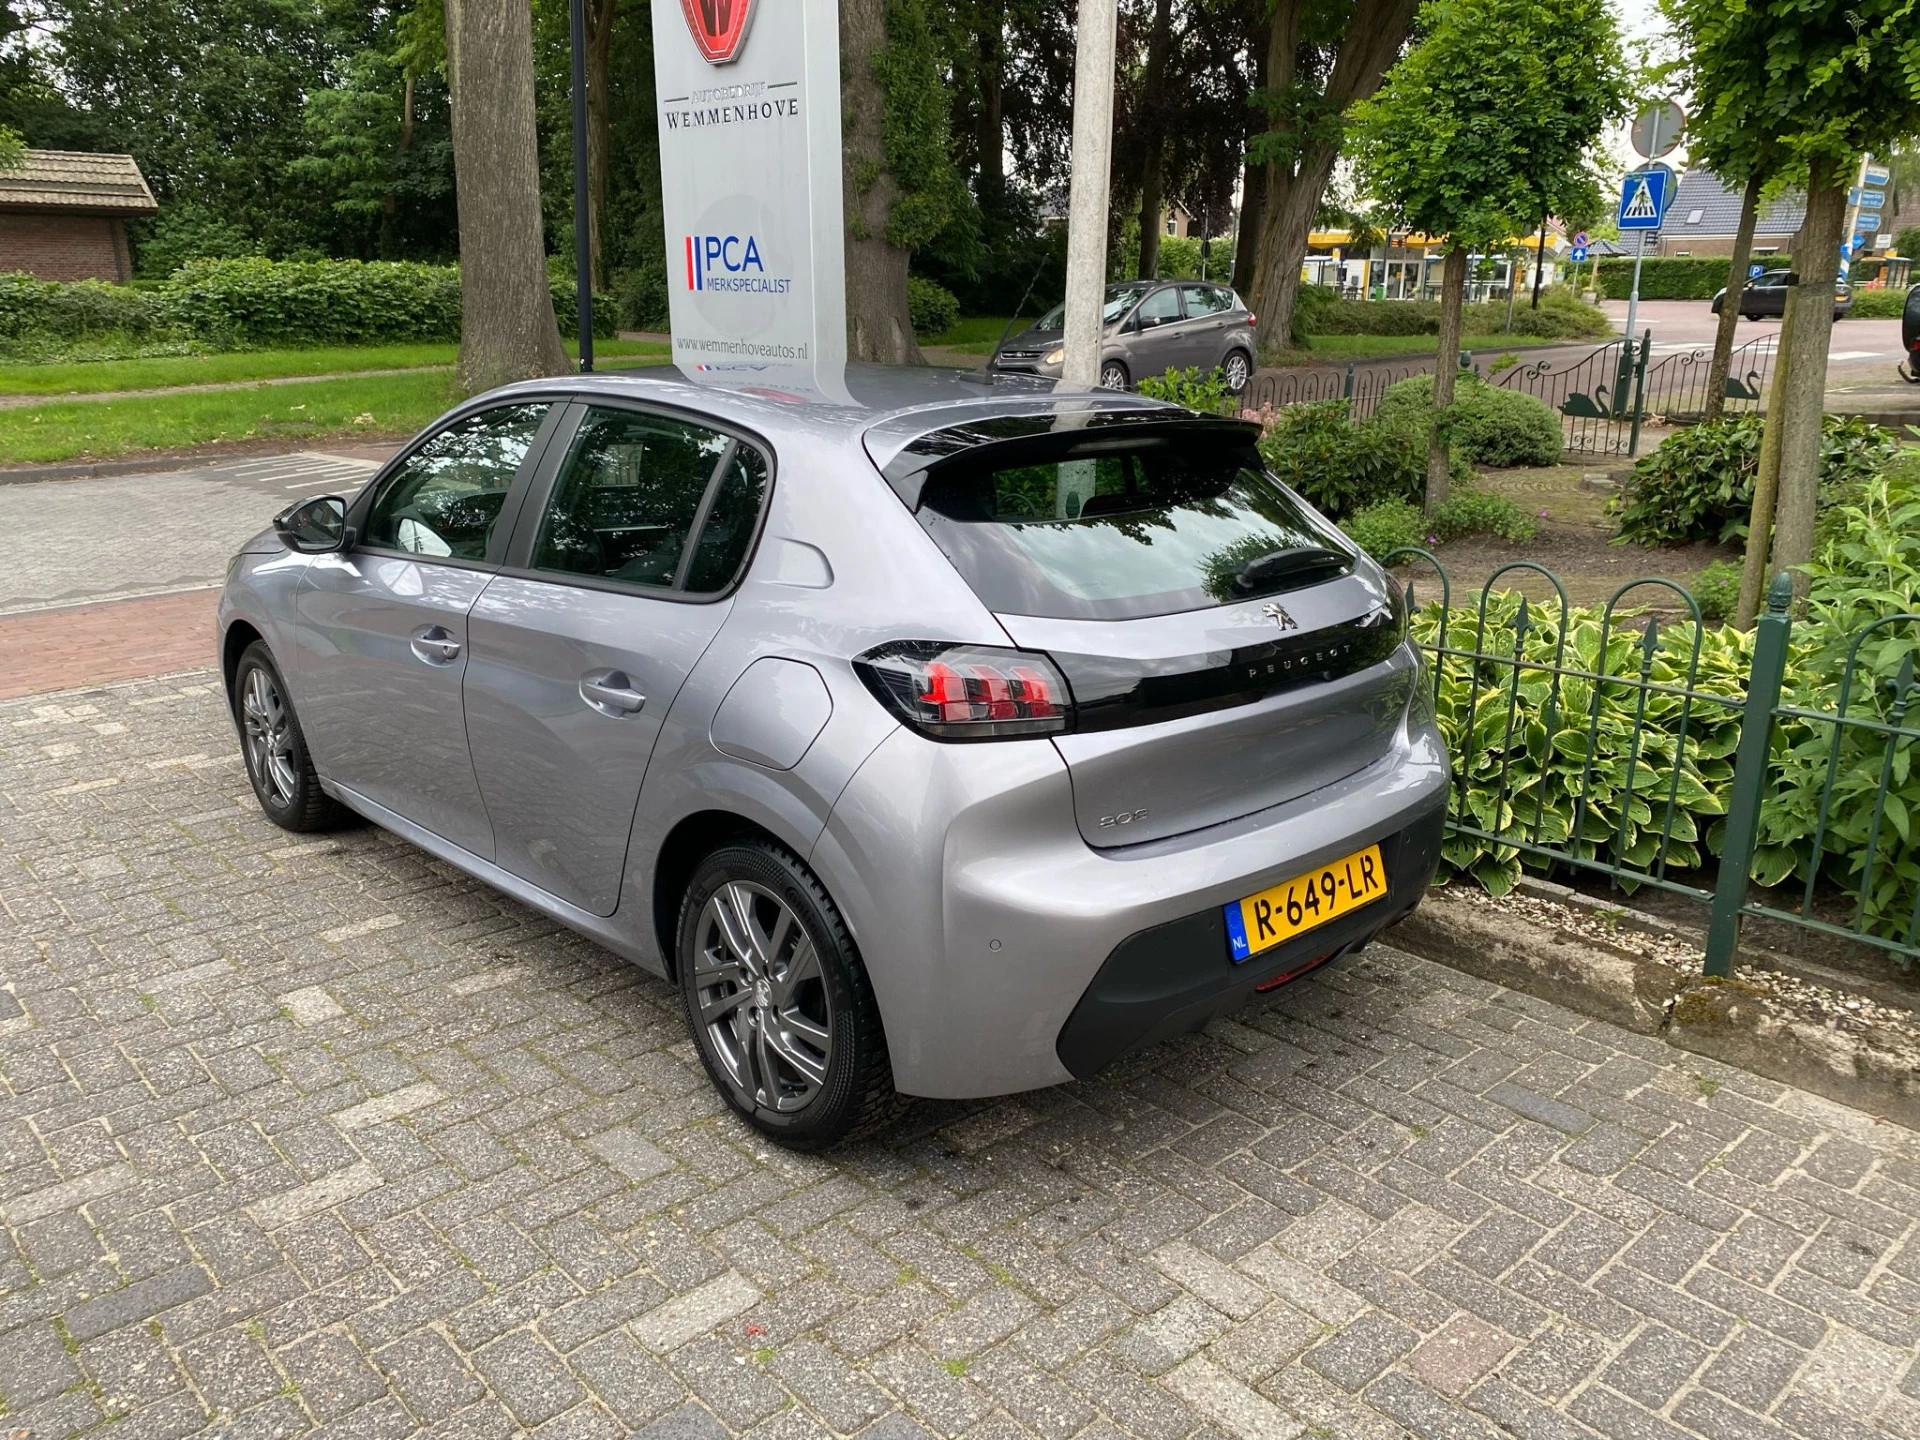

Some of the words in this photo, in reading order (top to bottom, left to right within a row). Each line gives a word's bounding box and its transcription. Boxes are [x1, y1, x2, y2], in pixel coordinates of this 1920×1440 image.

[665, 98, 799, 130] WEMMENHOVE
[705, 235, 764, 272] PCA
[706, 277, 792, 294] MERKSPECIALIST
[677, 337, 809, 360] www.wemmenhoveautos.nl
[1249, 645, 1351, 679] PEUGEOT
[1254, 854, 1379, 941] R-649-LR
[1232, 935, 1247, 950] NL
